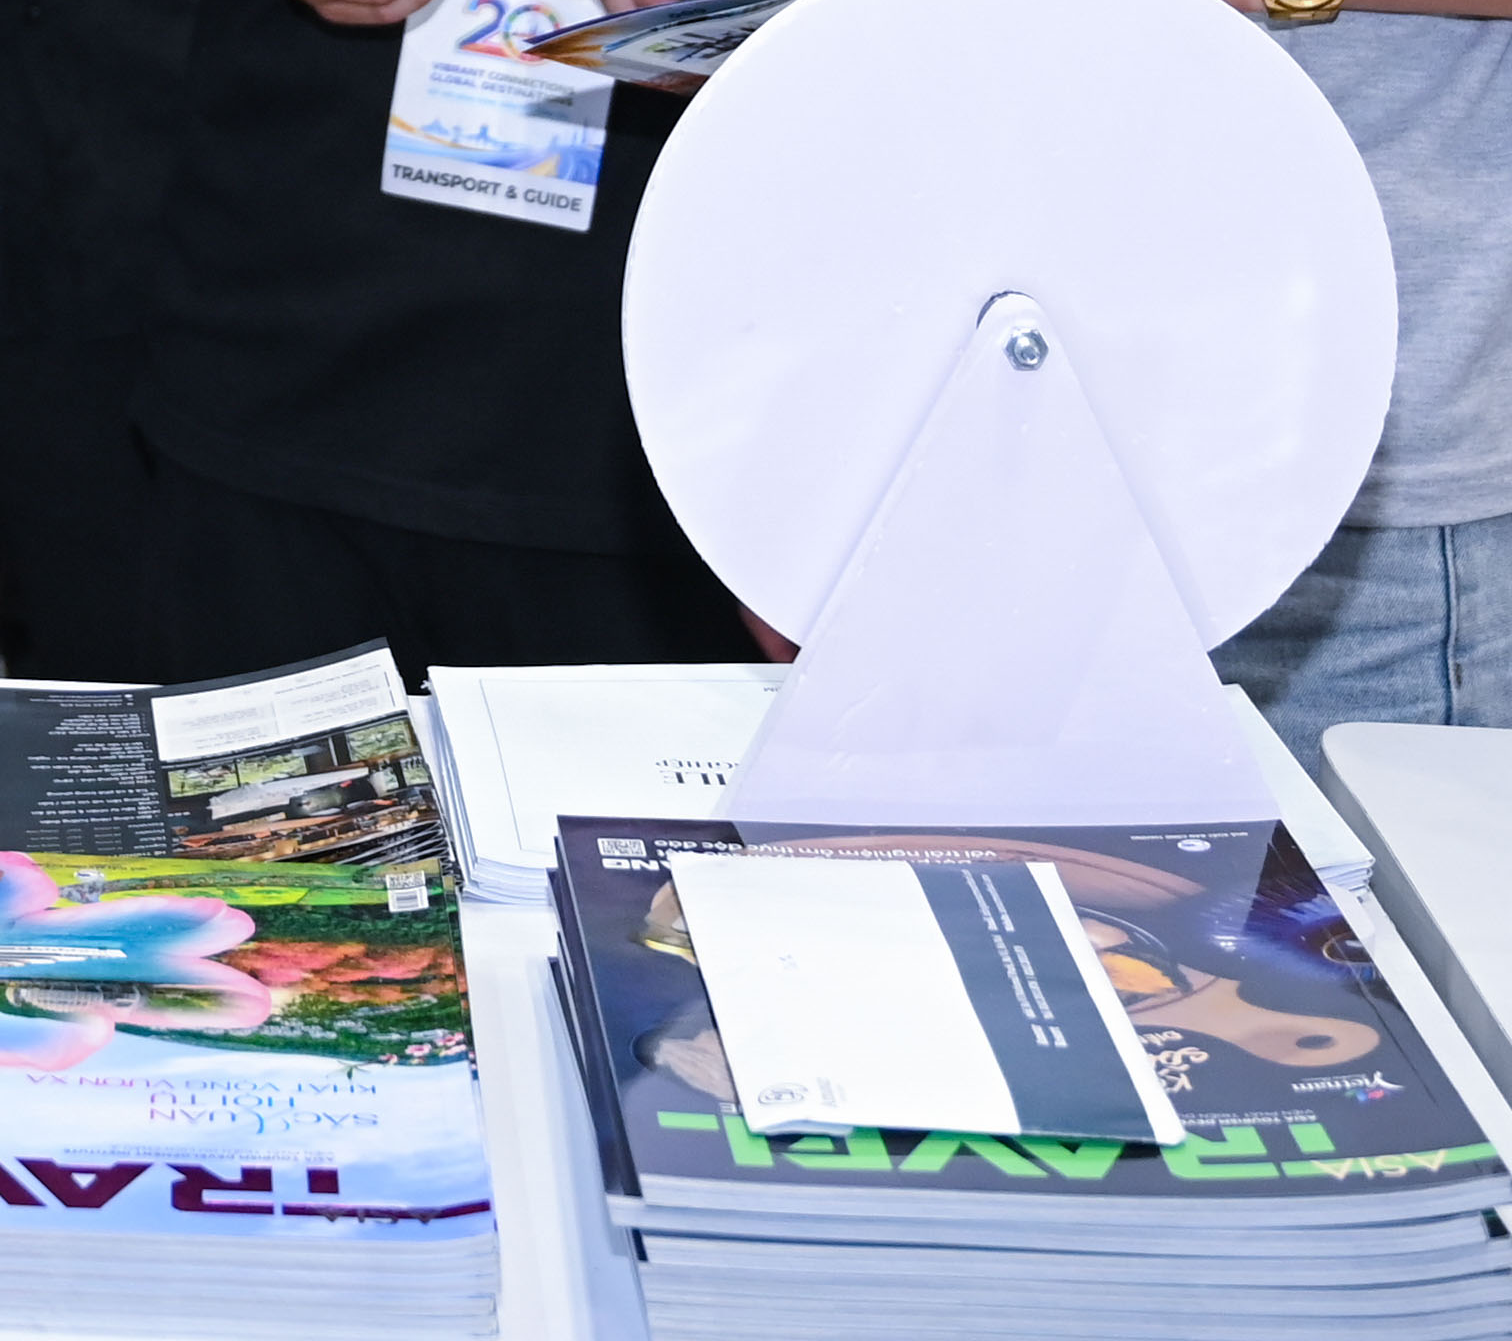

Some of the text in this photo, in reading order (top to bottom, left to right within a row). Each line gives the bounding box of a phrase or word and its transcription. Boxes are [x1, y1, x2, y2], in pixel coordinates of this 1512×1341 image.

[429, 71, 477, 88] GLOBAL
[431, 61, 577, 96] VIBRANT CONNECTIONS
[392, 163, 583, 213] TRANSPORT & GUIDE
[838, 844, 918, 860] nghiệm
[1290, 1070, 1405, 1095] Vietnam
[1219, 1115, 1281, 1126] TOURISM
[1310, 1148, 1449, 1182] ASIA
